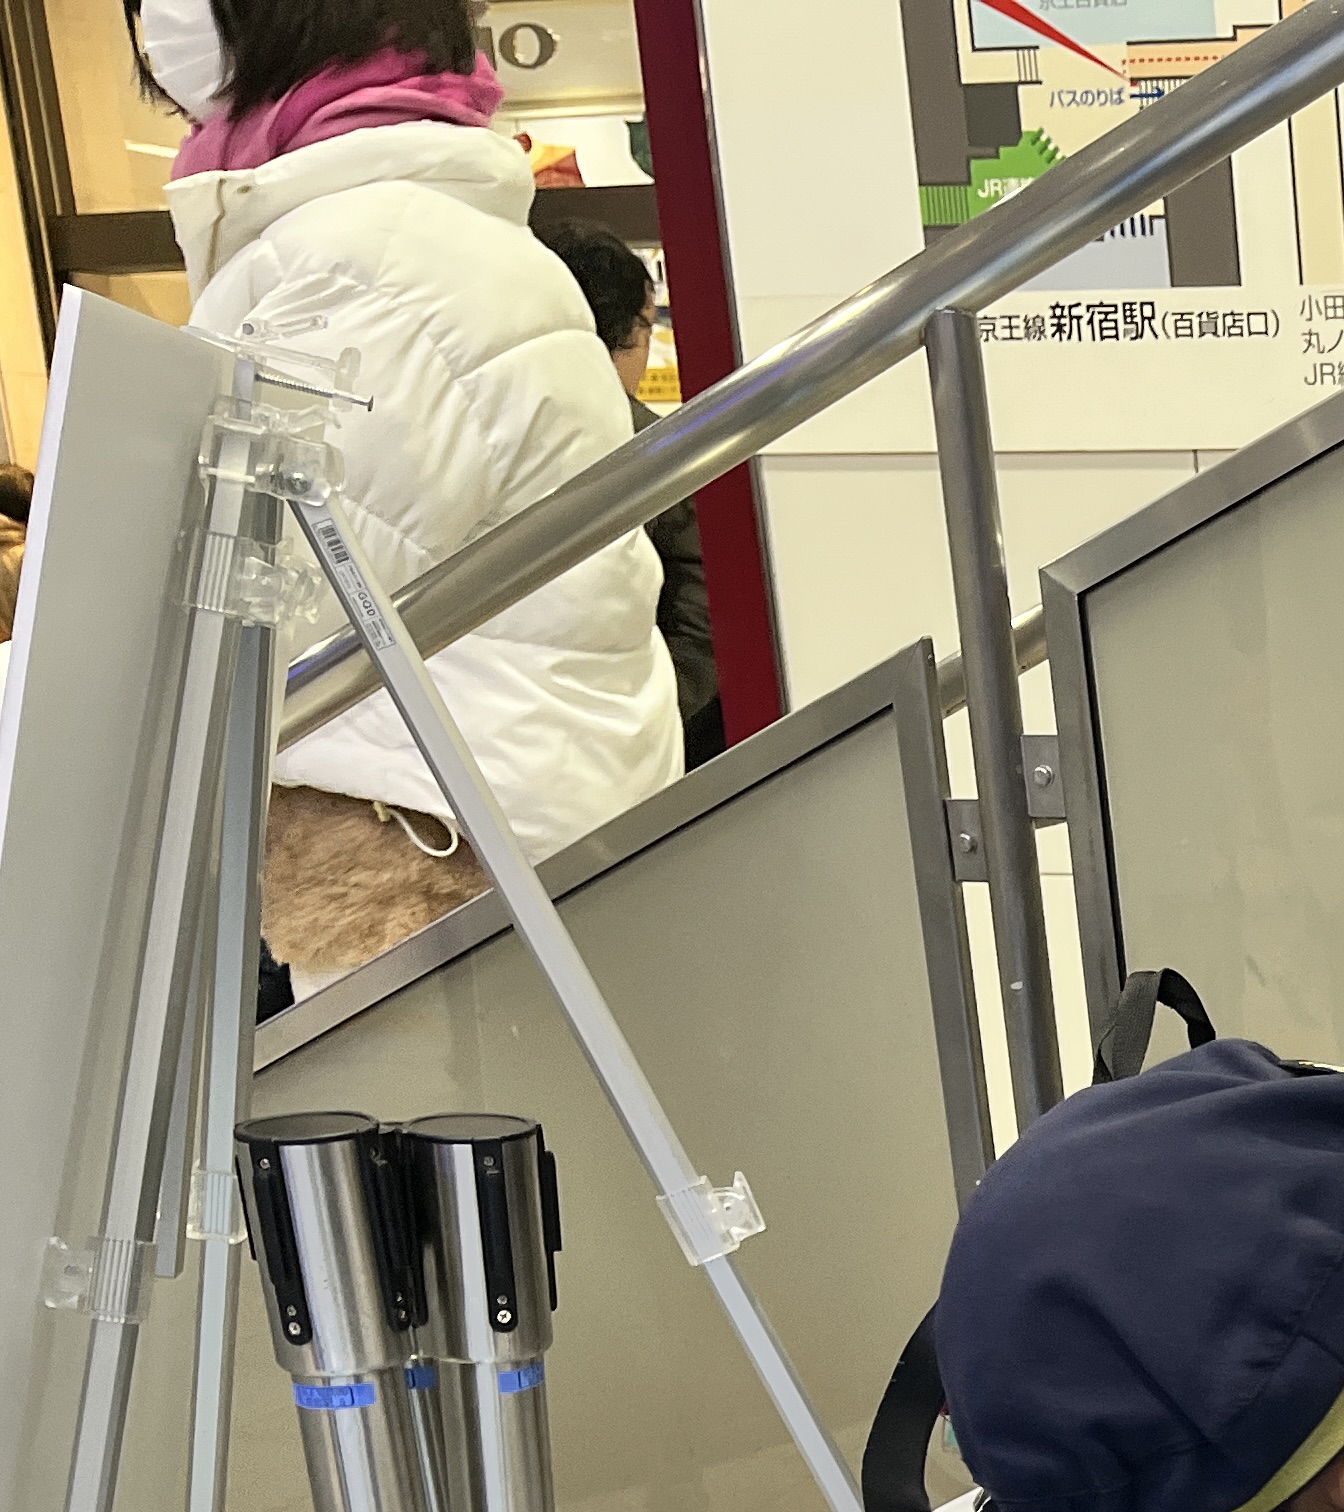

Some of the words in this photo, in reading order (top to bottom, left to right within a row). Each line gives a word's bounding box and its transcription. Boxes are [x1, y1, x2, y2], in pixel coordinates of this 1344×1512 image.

[1050, 87, 1125, 108] バスのりば
